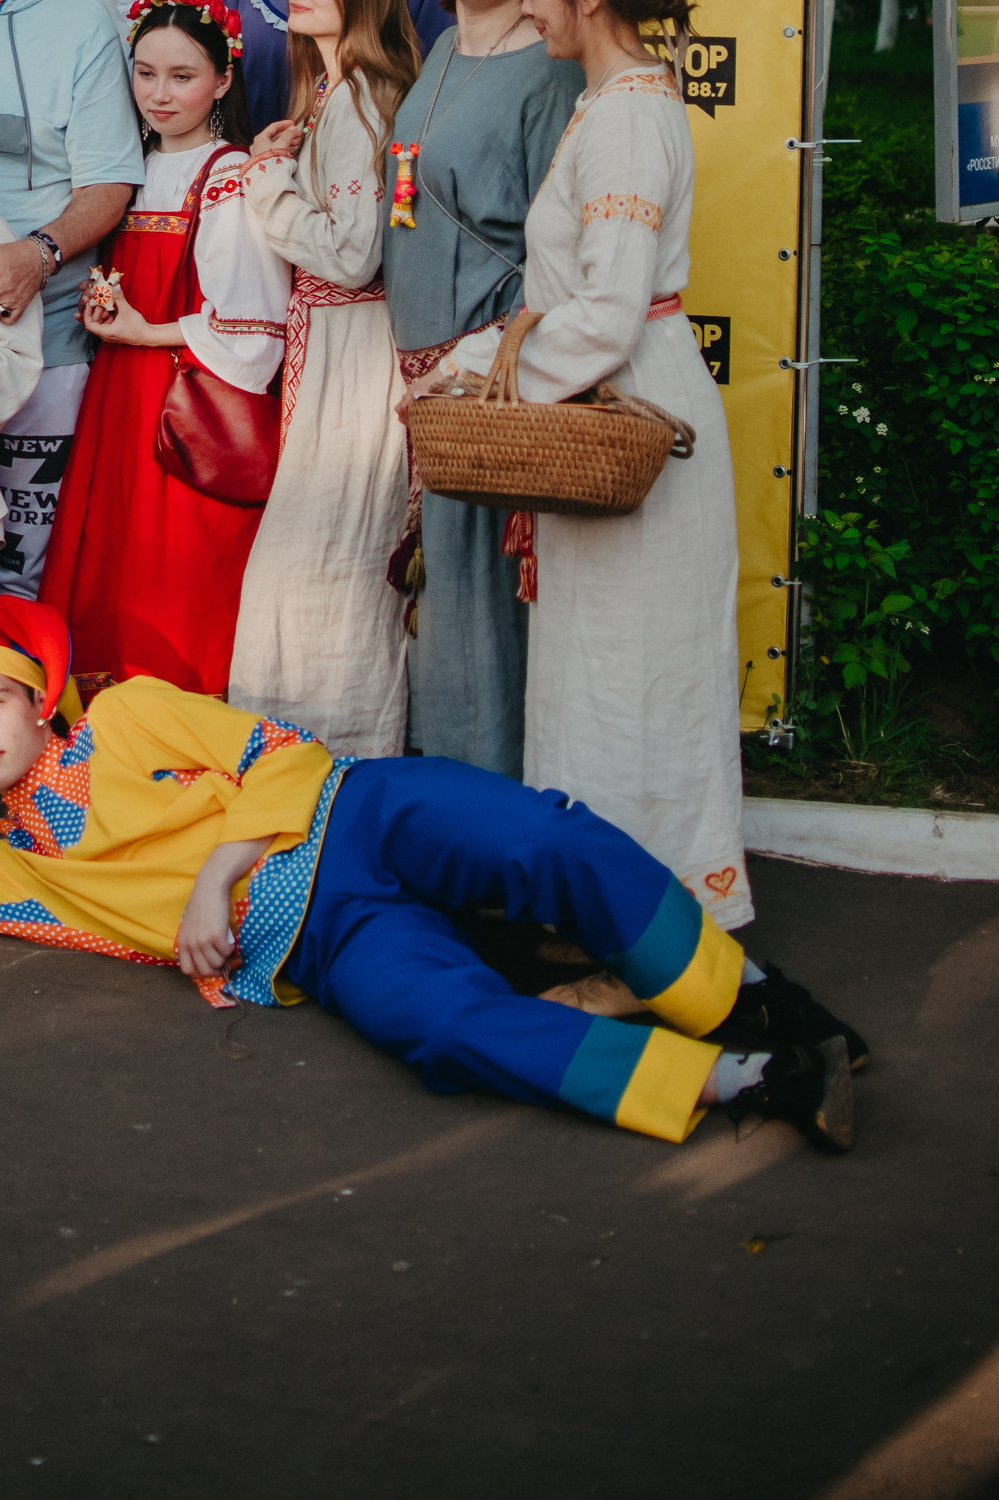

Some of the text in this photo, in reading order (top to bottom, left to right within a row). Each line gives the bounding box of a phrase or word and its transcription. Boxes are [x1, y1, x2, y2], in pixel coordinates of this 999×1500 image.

[687, 81, 728, 98] 88.7
[4, 439, 64, 453] NEW
[8, 510, 56, 526] ORK
